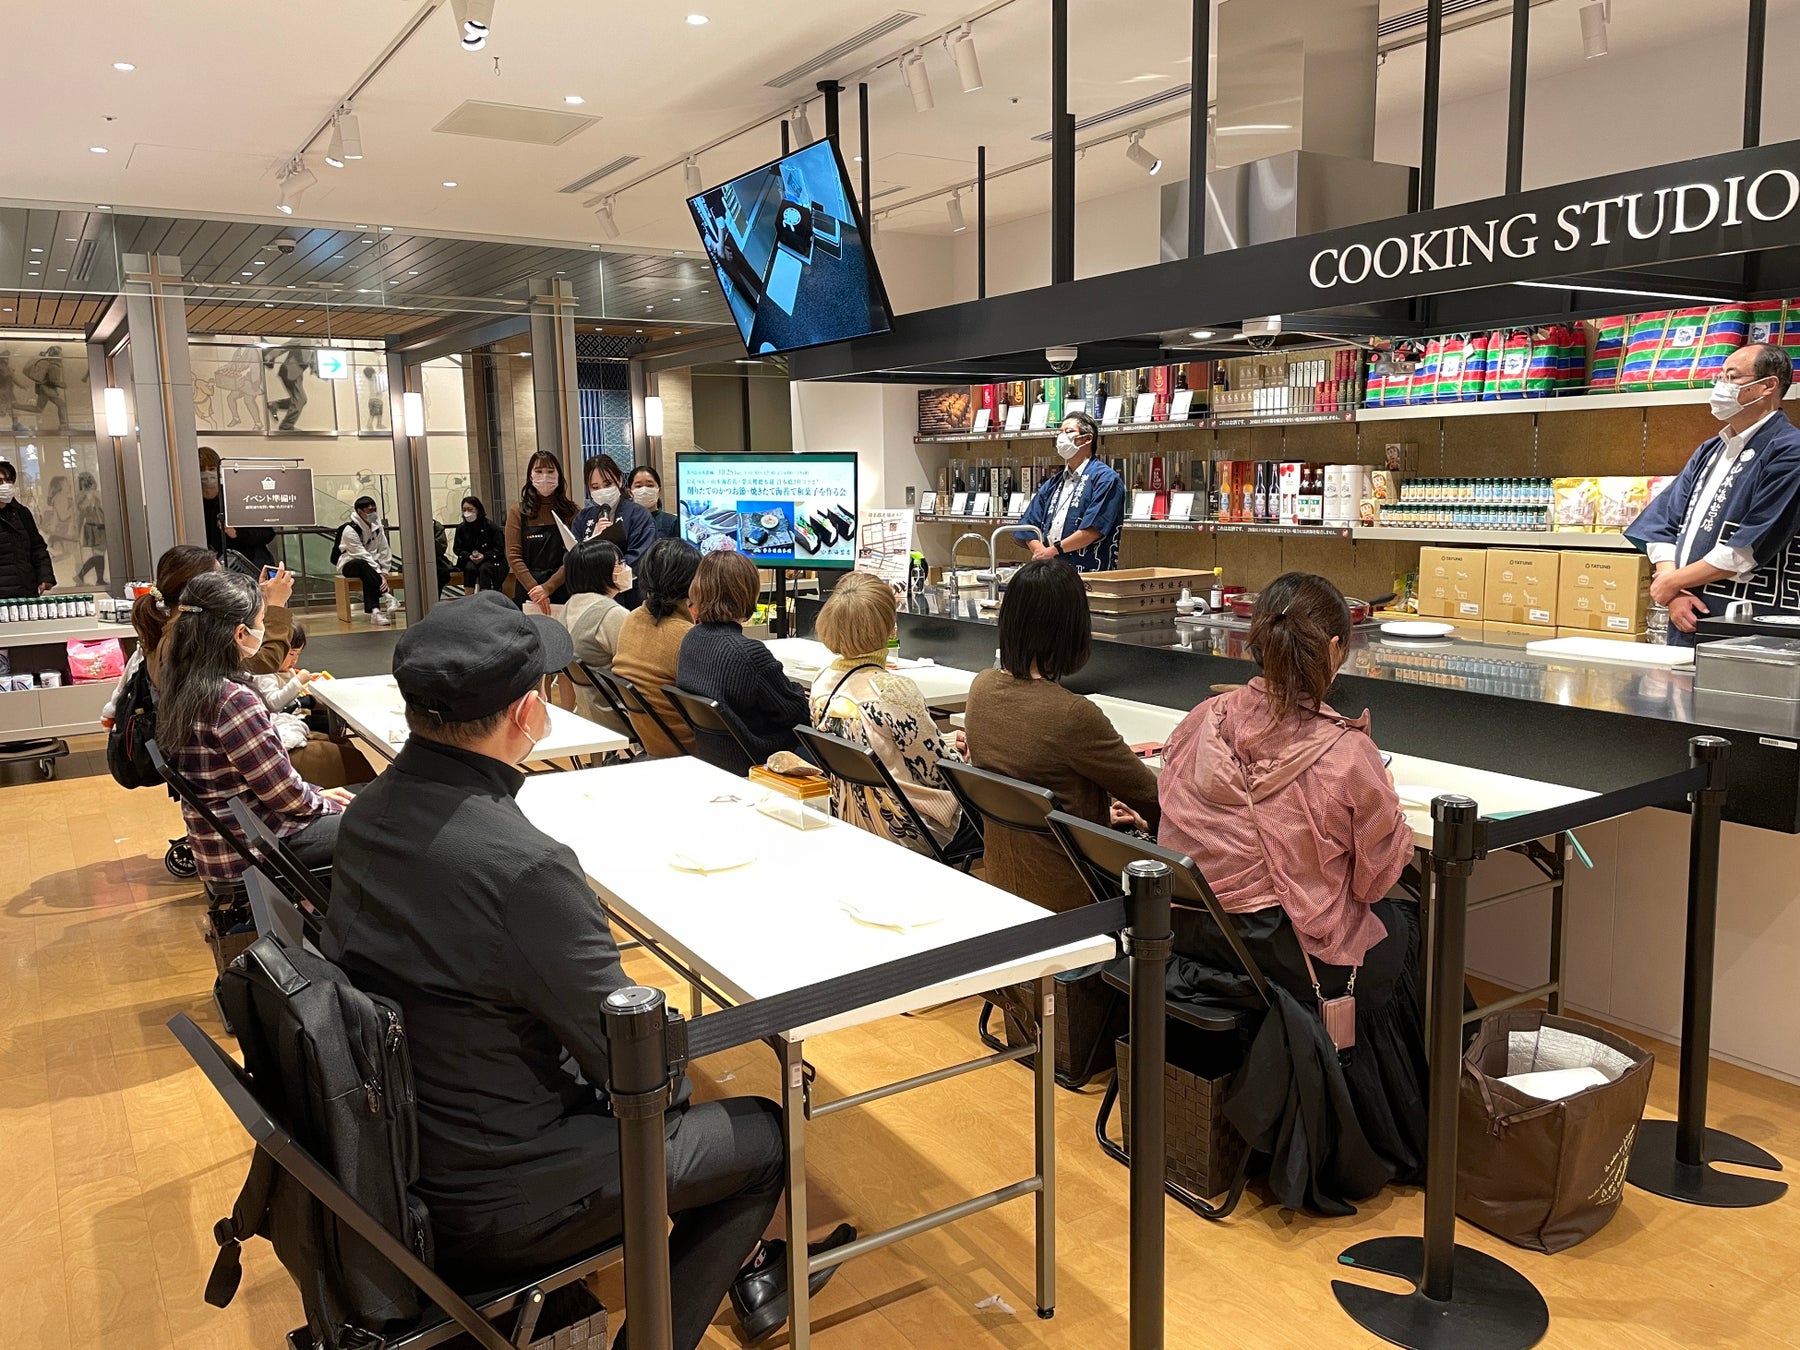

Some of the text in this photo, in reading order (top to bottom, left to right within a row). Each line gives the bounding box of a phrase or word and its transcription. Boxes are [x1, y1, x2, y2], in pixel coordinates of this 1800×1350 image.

[1308, 168, 1800, 289] COOKING STUDIO
[242, 494, 296, 502] イベント準備中
[1700, 462, 1743, 532] 山本海苔店
